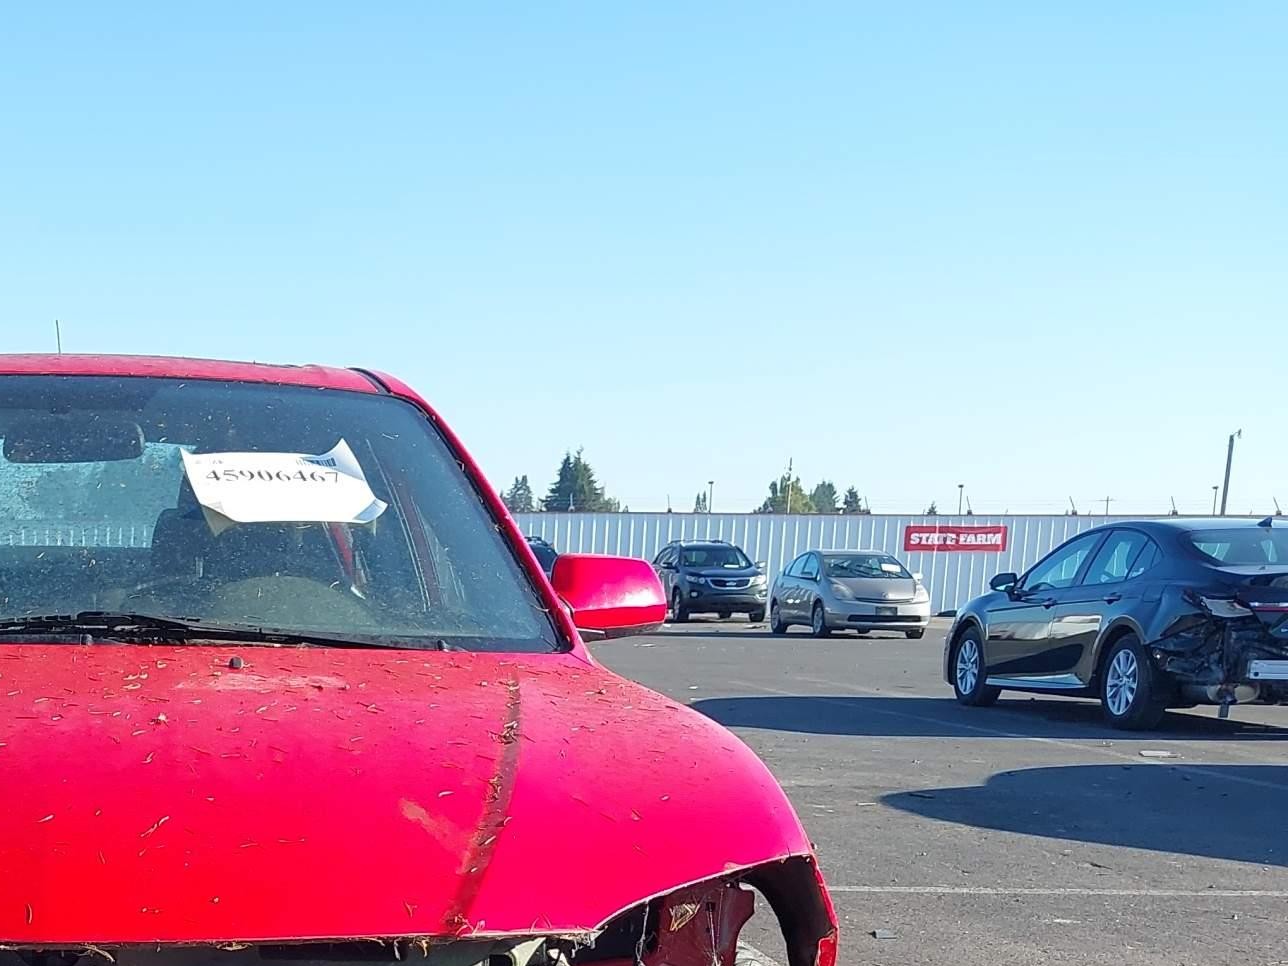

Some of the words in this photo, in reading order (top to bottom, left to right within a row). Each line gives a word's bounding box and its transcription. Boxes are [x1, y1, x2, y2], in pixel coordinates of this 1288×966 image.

[206, 469, 339, 483] 45906467
[909, 532, 957, 545] STATE
[958, 532, 1003, 545] FARM
